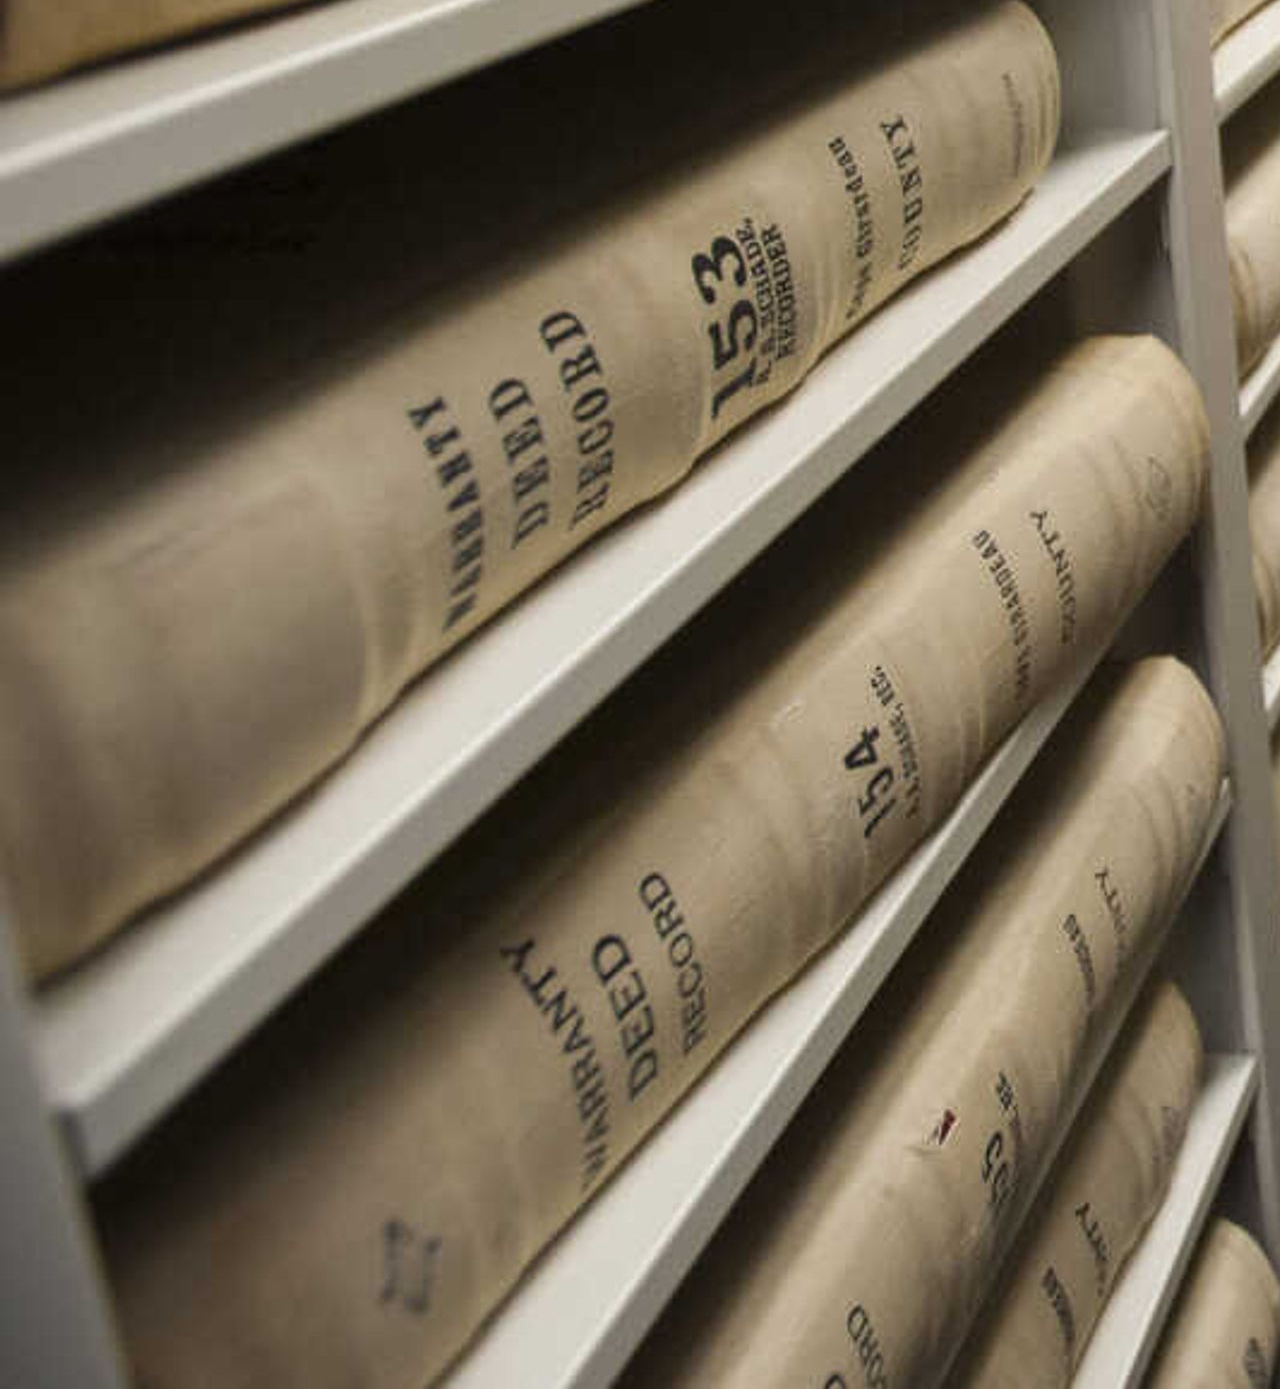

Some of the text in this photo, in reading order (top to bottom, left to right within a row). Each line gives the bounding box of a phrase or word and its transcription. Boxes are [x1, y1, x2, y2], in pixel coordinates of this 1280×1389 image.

[879, 113, 924, 272] COUNTY
[691, 234, 758, 421] 153
[760, 222, 796, 361] RECORDER
[488, 377, 551, 551] DEED
[538, 310, 616, 532] RECORD
[406, 395, 485, 635] WARRANTY
[843, 723, 902, 839] 154
[590, 933, 660, 1102] DEED
[638, 871, 708, 1057] RECORD
